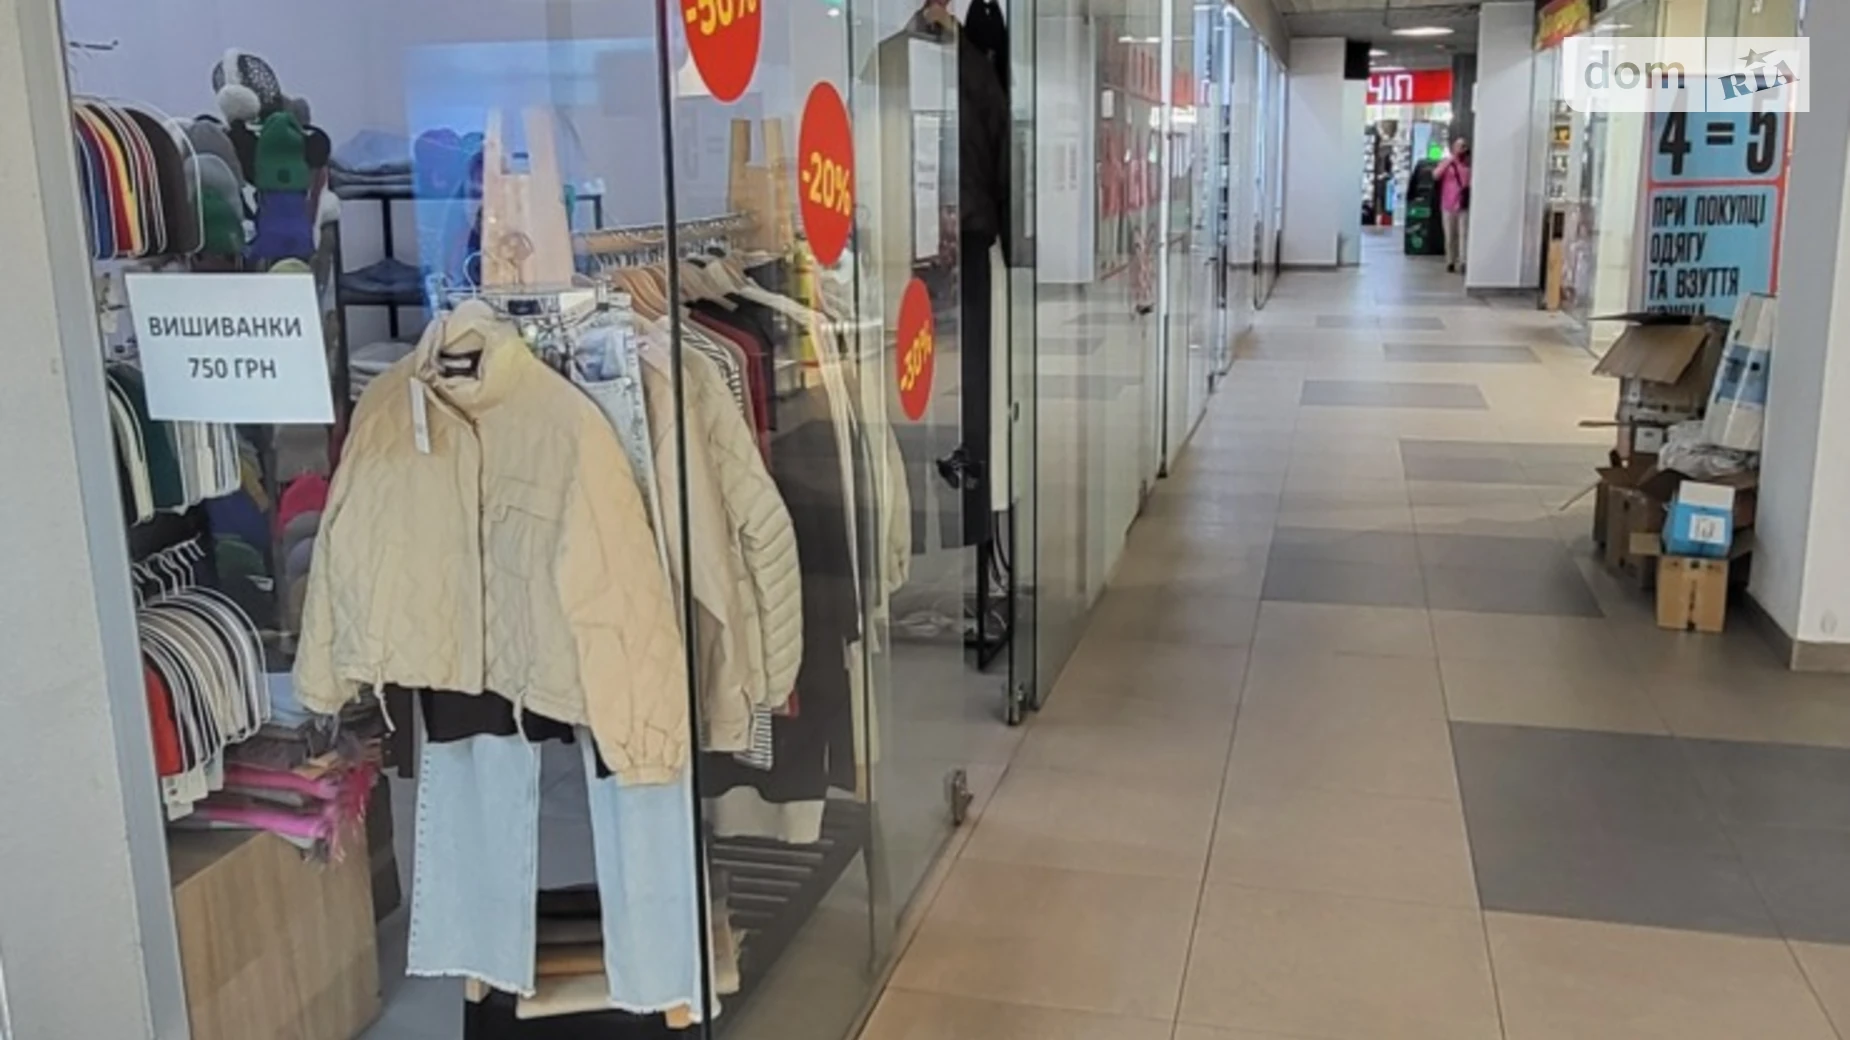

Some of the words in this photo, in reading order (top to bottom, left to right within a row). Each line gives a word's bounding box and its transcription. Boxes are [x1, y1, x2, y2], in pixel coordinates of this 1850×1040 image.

[686, 0, 757, 35] -5
[1658, 84, 1692, 176] 4
[1746, 84, 1778, 174] 5
[802, 151, 851, 217] -20%
[1652, 196, 1687, 227] ПРИ
[1694, 193, 1766, 228] ПОКУПЦІ
[1650, 232, 1706, 267] ОДЯГУ
[1649, 269, 1668, 299] ТА
[1675, 267, 1739, 298] ВЗУТТЯ
[149, 317, 303, 337] ВИШИВАНКИ
[188, 358, 228, 378] 750
[235, 360, 277, 379] ГРН
